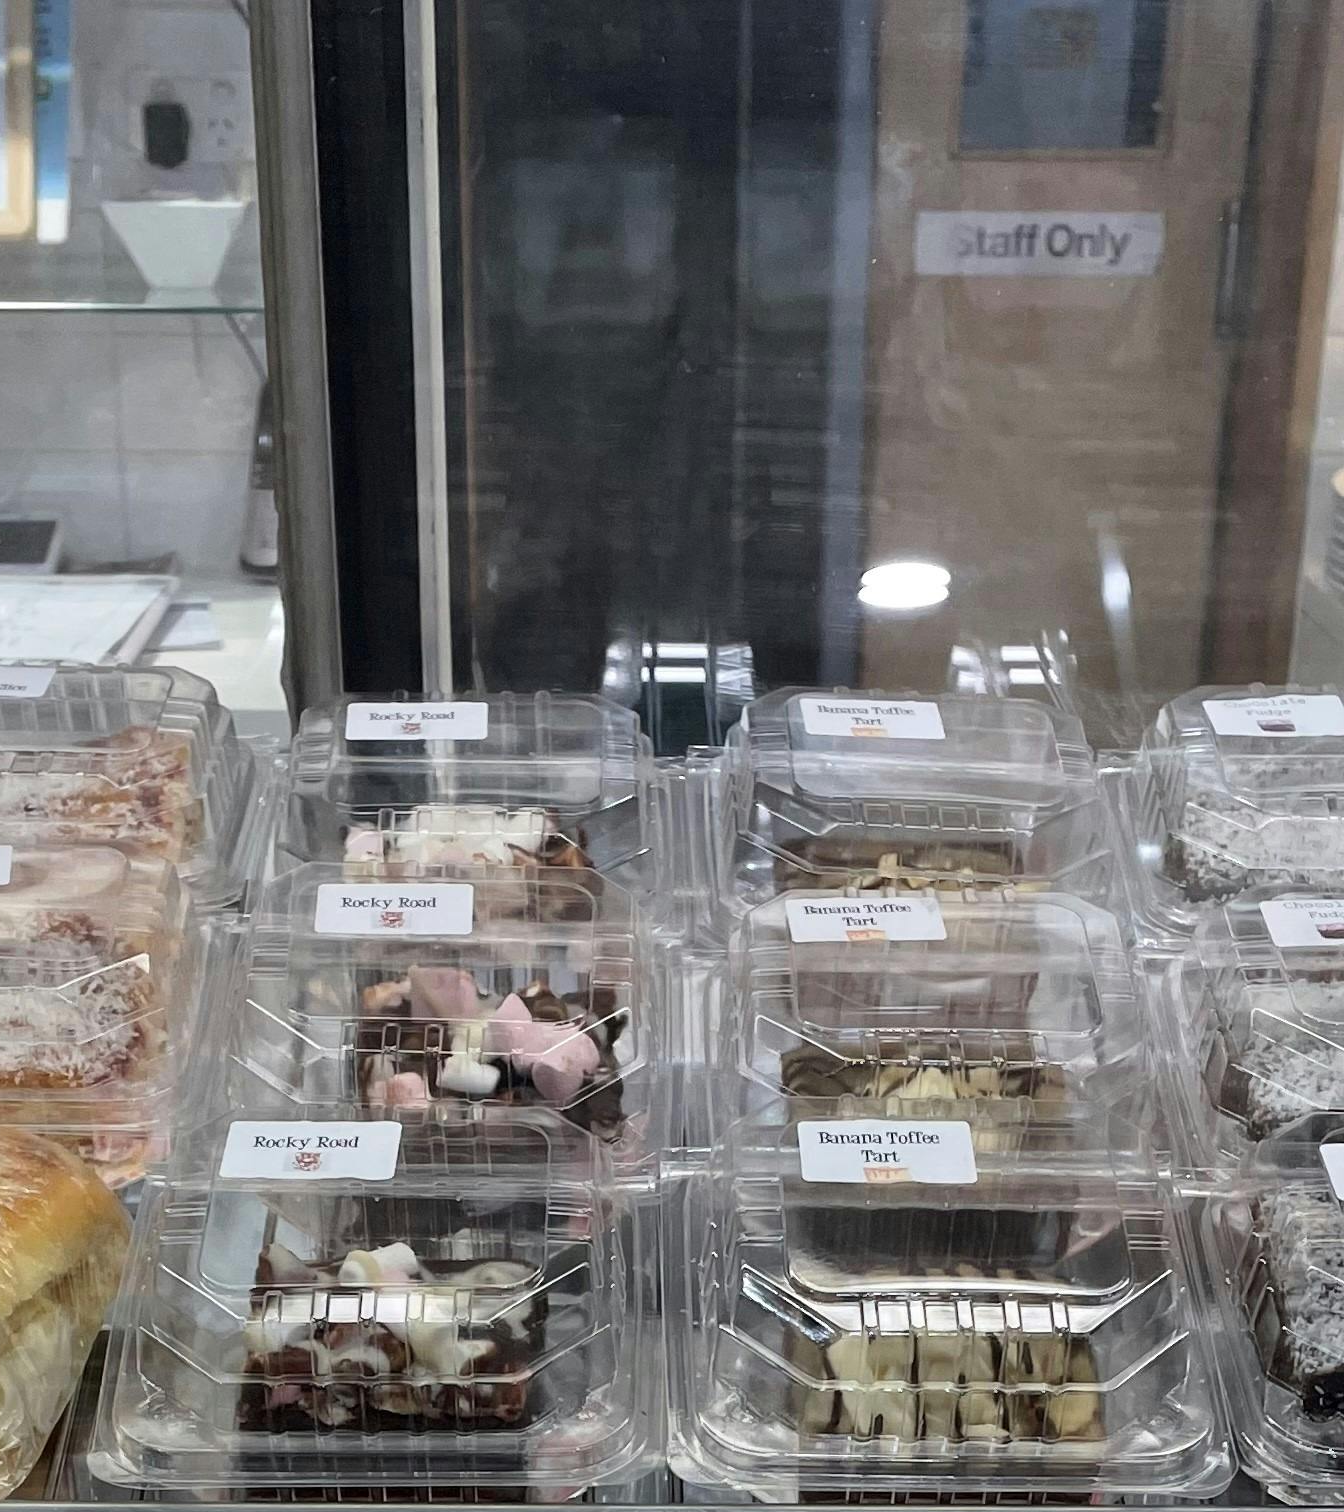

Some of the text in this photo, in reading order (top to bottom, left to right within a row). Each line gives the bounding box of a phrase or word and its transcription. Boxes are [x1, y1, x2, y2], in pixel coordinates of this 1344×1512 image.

[1045, 222, 1134, 267] Only
[369, 711, 455, 721] Rocky Road
[340, 897, 437, 909] Rocky Road
[804, 903, 911, 915] Banana Toffee
[842, 916, 877, 926] Tart
[253, 1135, 359, 1150] Rocky Road
[817, 1131, 940, 1145] Banana Toffee
[861, 1149, 900, 1163] Tart
